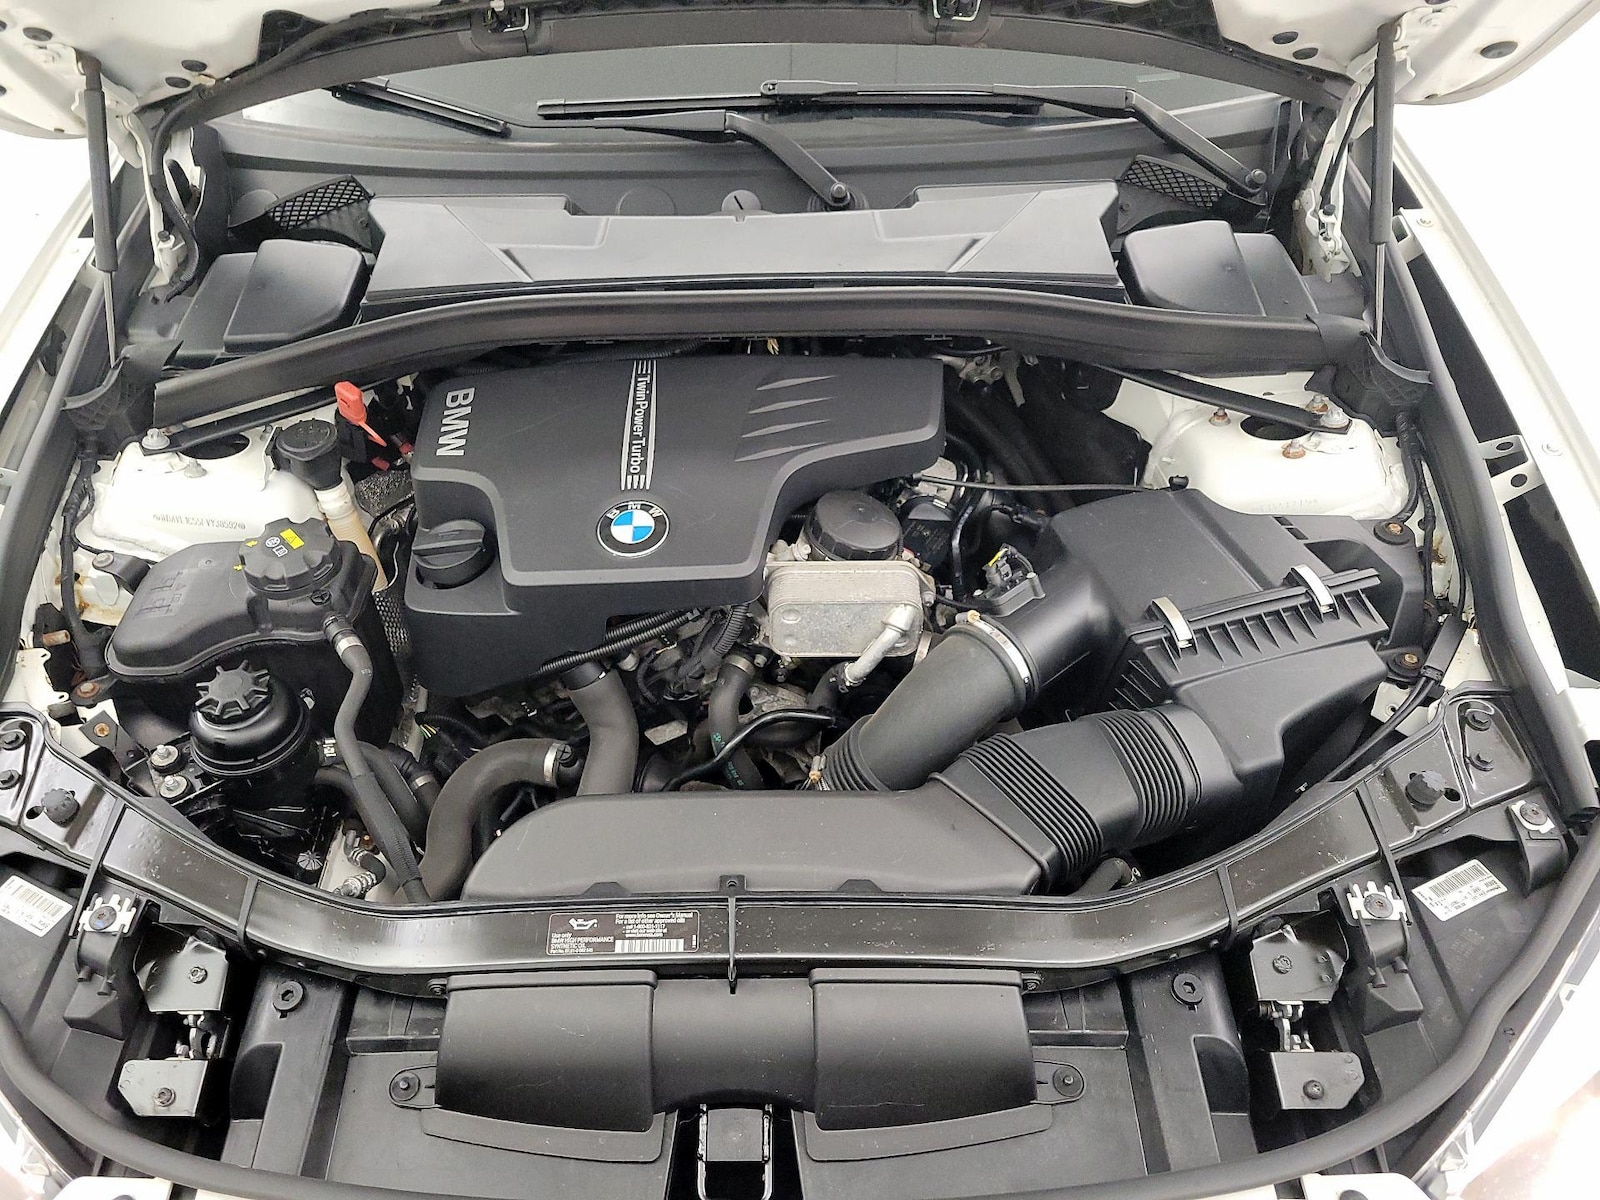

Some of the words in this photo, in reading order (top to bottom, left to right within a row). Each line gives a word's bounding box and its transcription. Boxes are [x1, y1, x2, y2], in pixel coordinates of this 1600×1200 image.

[436, 387, 475, 456] BMW
[633, 375, 651, 437] TwinPower
[629, 437, 647, 474] Turbo
[606, 501, 663, 520] BMW
